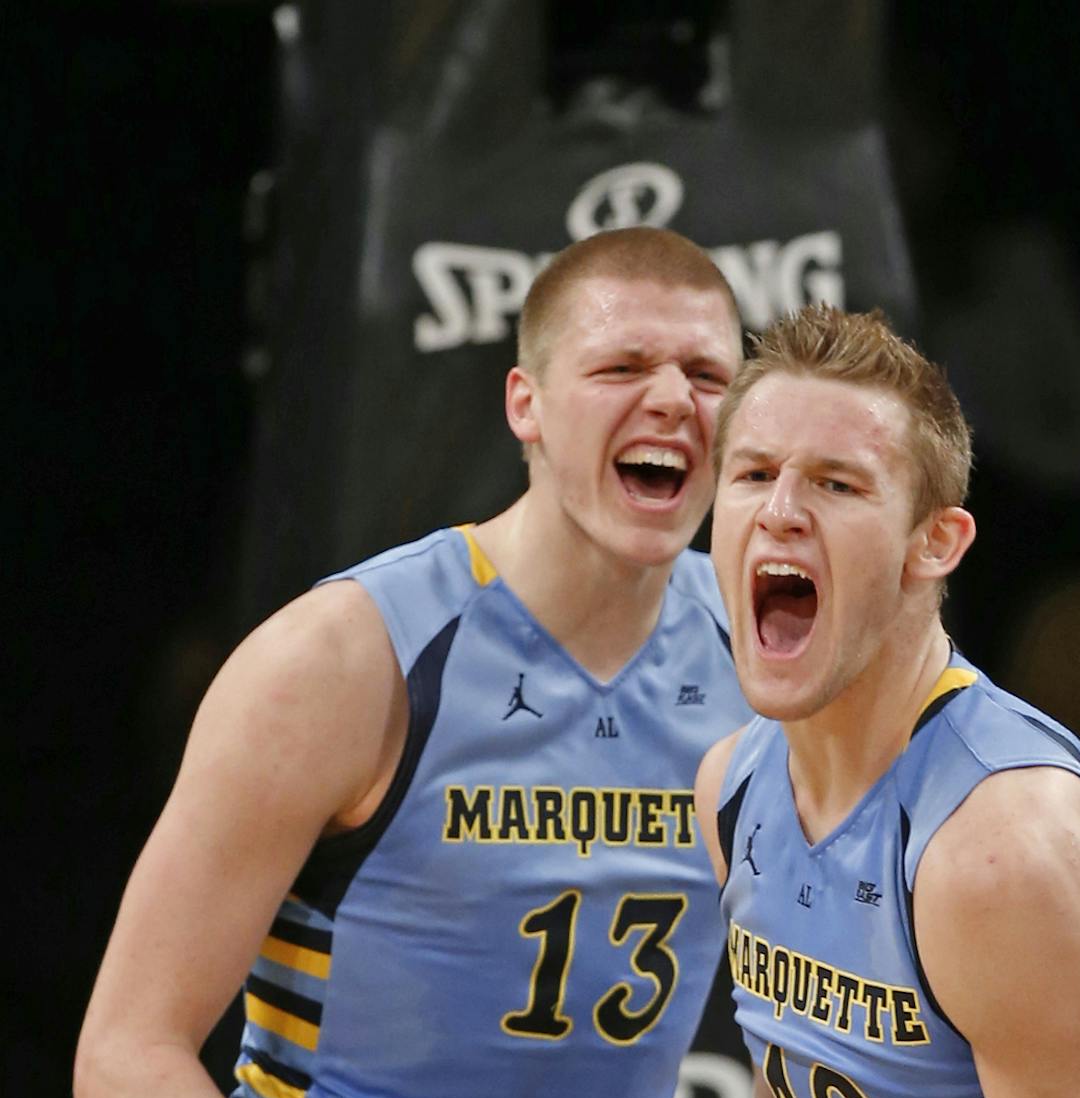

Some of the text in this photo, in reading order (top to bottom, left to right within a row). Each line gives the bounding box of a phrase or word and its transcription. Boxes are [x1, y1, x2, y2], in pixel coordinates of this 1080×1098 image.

[594, 716, 620, 739] AL
[442, 785, 697, 858] MARQUET
[797, 882, 813, 909] AL
[501, 889, 689, 1047] 13
